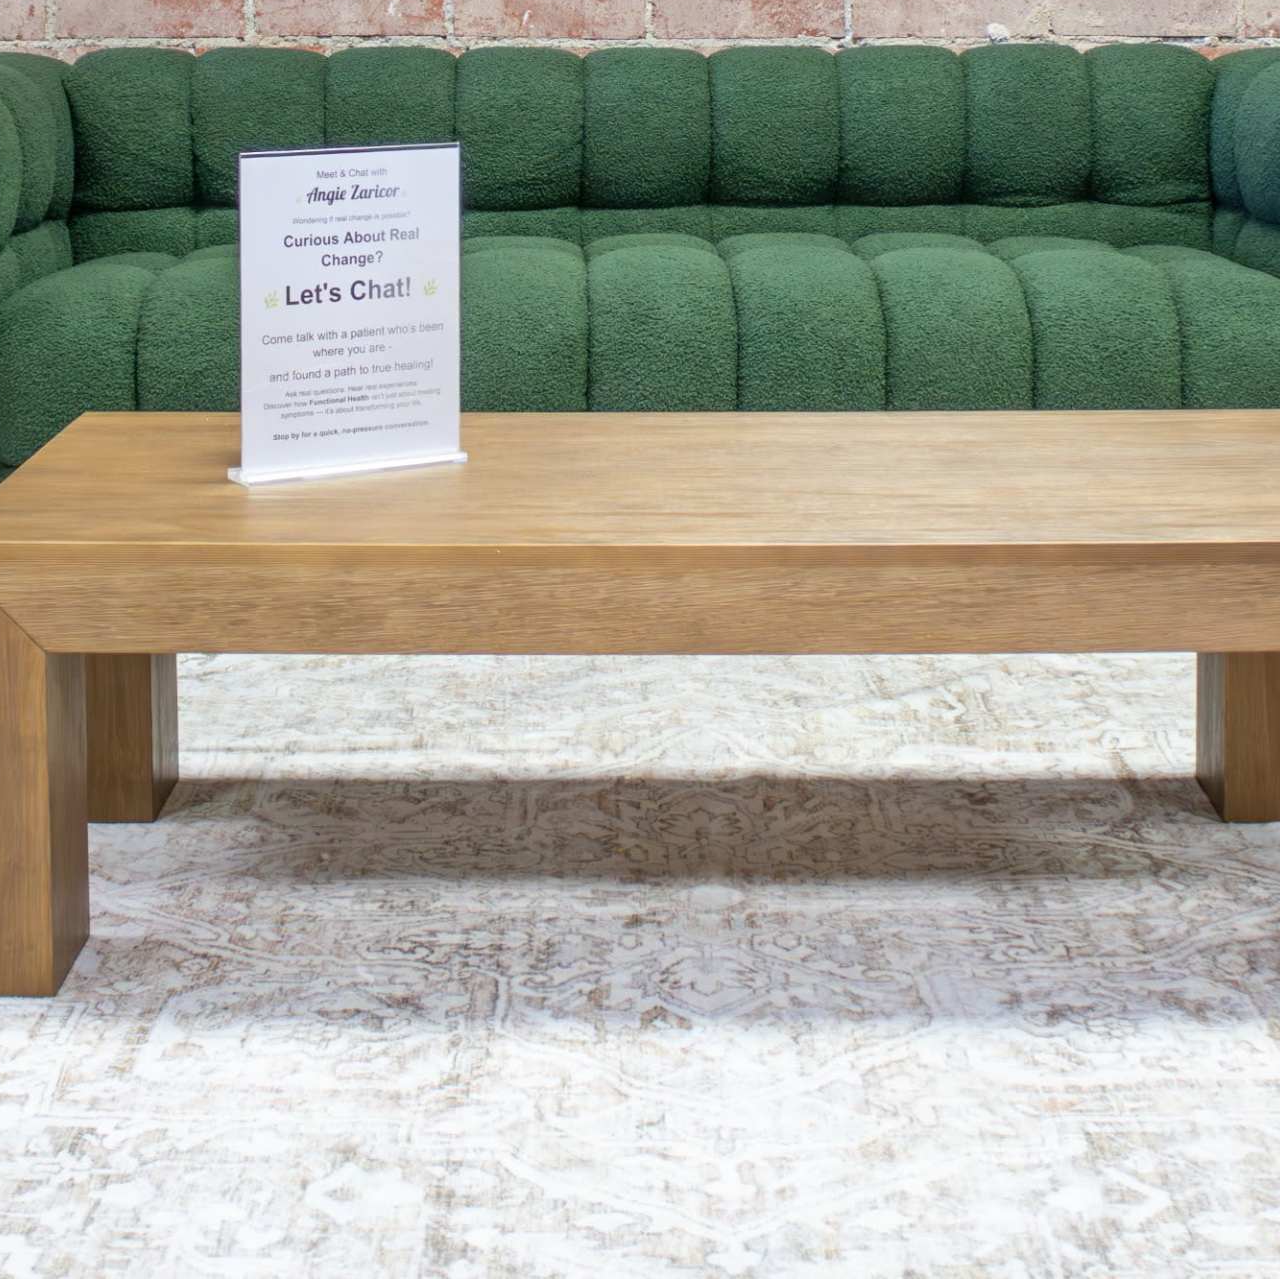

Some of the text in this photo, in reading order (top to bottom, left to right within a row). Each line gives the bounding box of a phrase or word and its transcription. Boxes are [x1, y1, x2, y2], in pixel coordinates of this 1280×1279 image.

[316, 167, 388, 179] Meet & Chat with
[306, 184, 400, 206] Angie Zaricor
[283, 227, 420, 248] Curious About Real
[321, 251, 384, 269] Change?
[285, 276, 411, 306] Let's Chat!
[262, 321, 444, 345] Come talk with a patient who's been
[312, 347, 345, 357] where
[347, 346, 366, 357] you
[369, 344, 385, 353] are
[269, 357, 434, 383] and found a path to true healing!
[309, 397, 346, 406] Functional
[347, 394, 369, 402] Health
